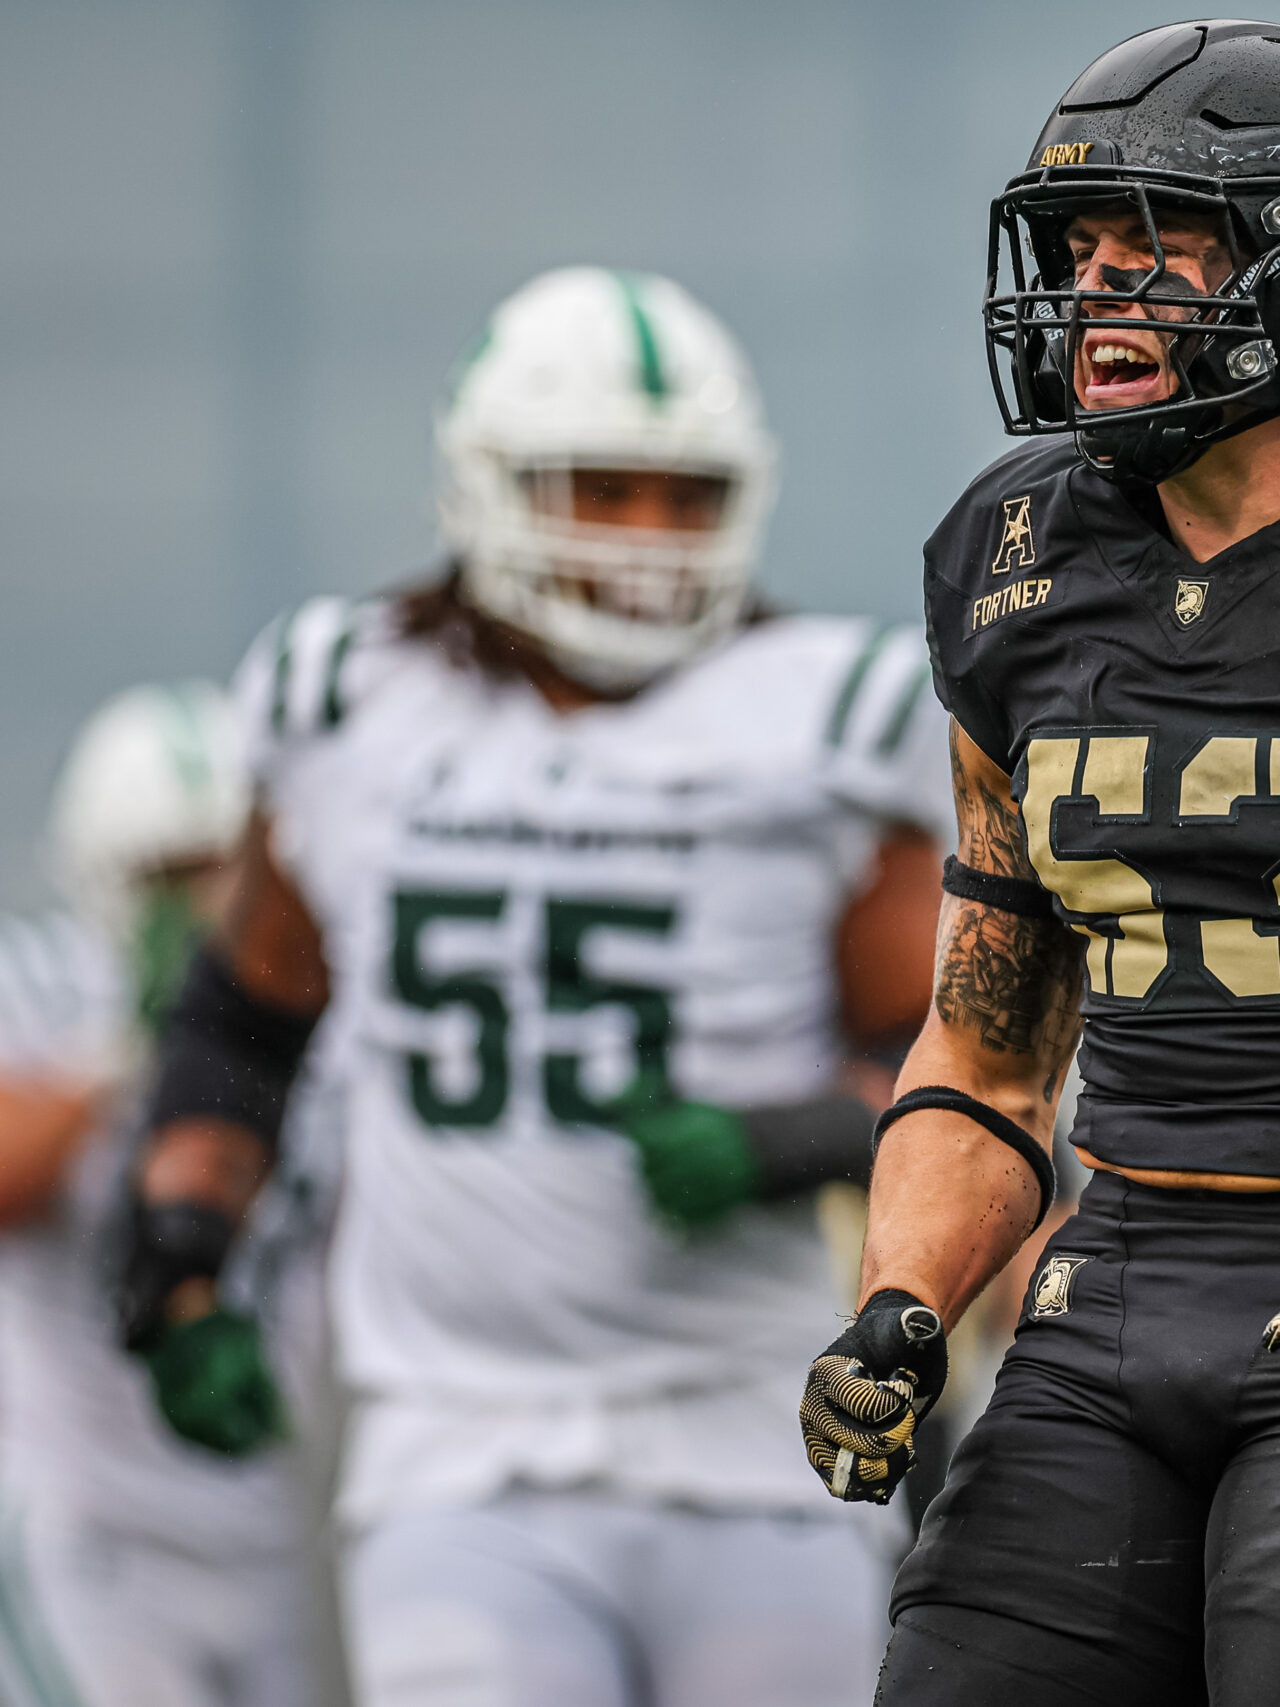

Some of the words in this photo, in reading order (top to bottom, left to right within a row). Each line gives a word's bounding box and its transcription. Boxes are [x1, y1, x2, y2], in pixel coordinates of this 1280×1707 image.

[1040, 142, 1094, 167] ARMY
[972, 578, 1053, 631] FORTNER
[389, 888, 676, 1127] 55
